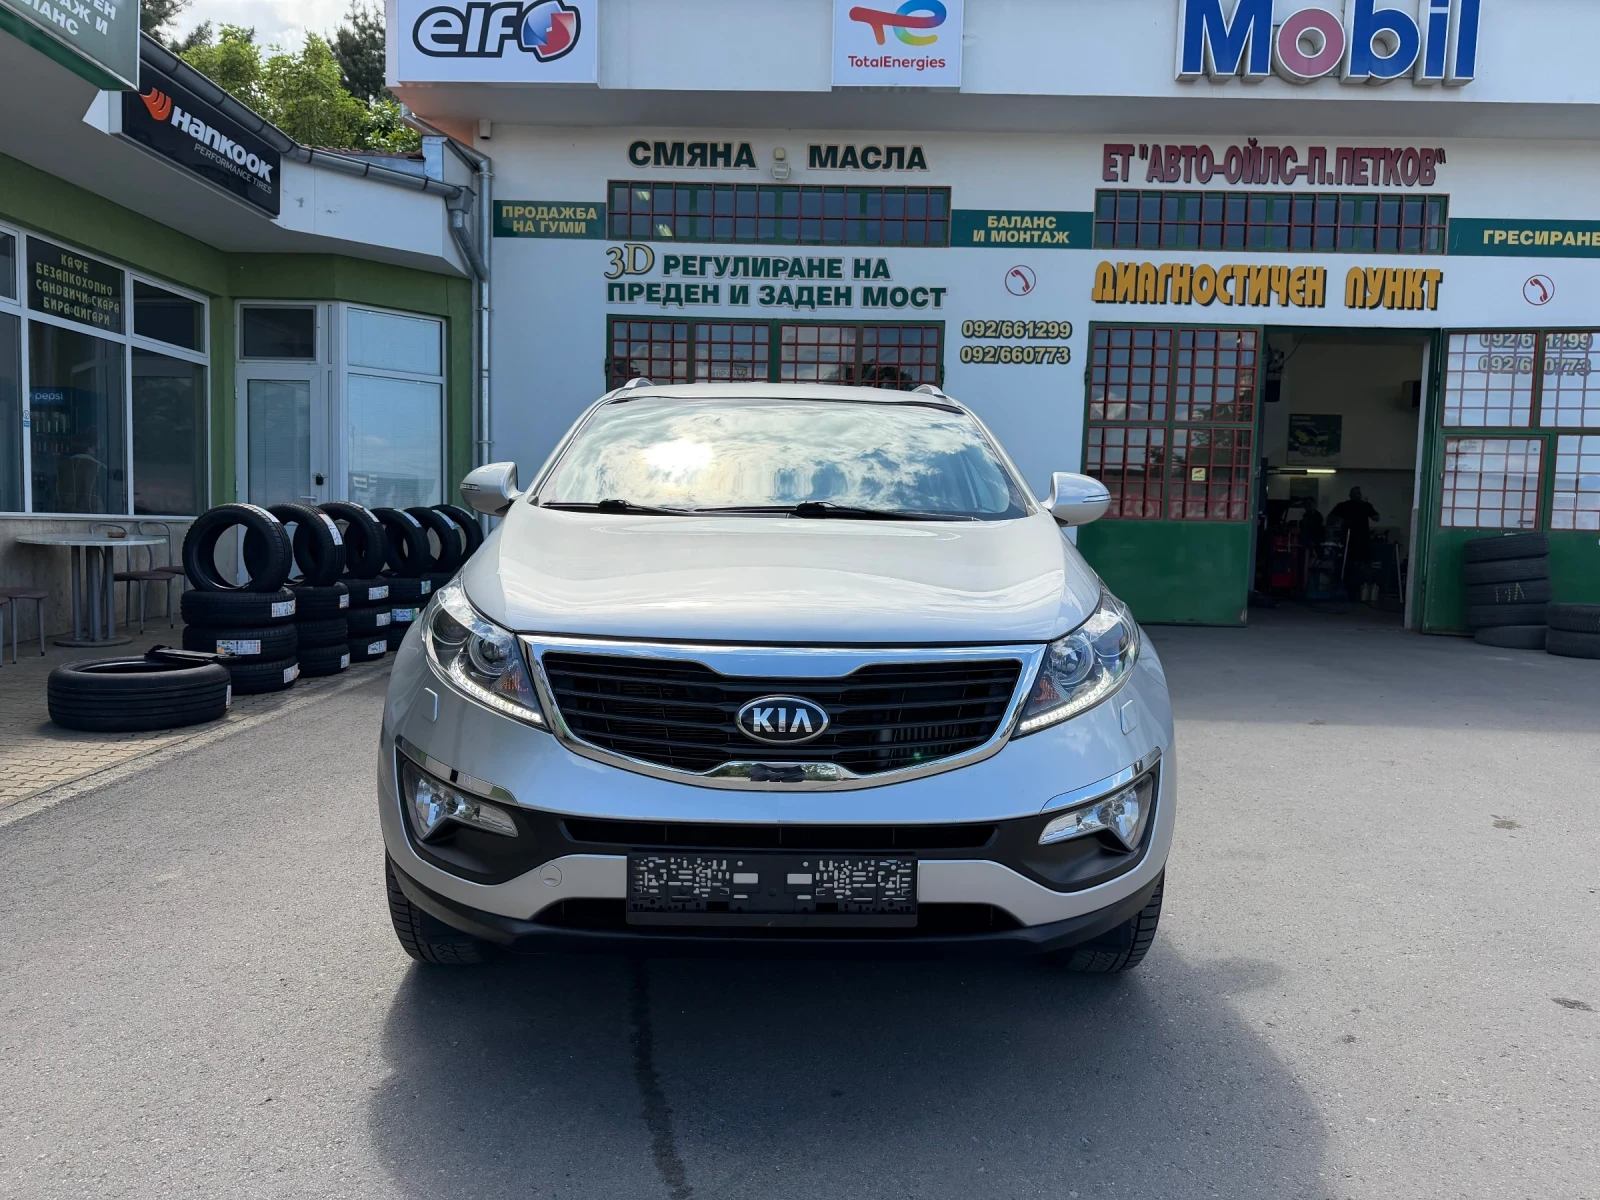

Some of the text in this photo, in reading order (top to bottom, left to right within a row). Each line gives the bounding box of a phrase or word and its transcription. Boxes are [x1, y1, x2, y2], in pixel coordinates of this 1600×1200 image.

[413, 2, 523, 58] elf
[1176, 0, 1481, 86] Mobil
[848, 56, 946, 71] TotalEnergies
[628, 140, 929, 171] СМЯНА МАСЛА
[1103, 144, 1135, 182] ЕТ
[194, 142, 272, 194] PERFORMANCE TIRES
[502, 206, 598, 220] ПРОДАЖБА
[988, 216, 1057, 229] БАЛАНС
[513, 220, 586, 234] НА ГУМИ
[973, 230, 1070, 244] И МОНТАЖ
[1483, 229, 1600, 247] ГРЕСИРАНЕ
[61, 253, 89, 273] КАФЕ
[604, 243, 892, 280] 3D РЕГУЛИРАНЕ НА
[1092, 260, 1443, 310] ДИАГНОСТИЧЕН ПУНКТ
[43, 296, 70, 315] БИРА
[606, 282, 948, 311] ПРЕДЕН И ЗАДЕН МОСТ
[962, 320, 1072, 339] 092/661299
[1479, 333, 1593, 350] 092/61299
[960, 346, 1071, 364] 092/660773
[1478, 355, 1592, 376] 092/60773
[34, 392, 63, 402] pepsi
[752, 707, 814, 733] KIA
